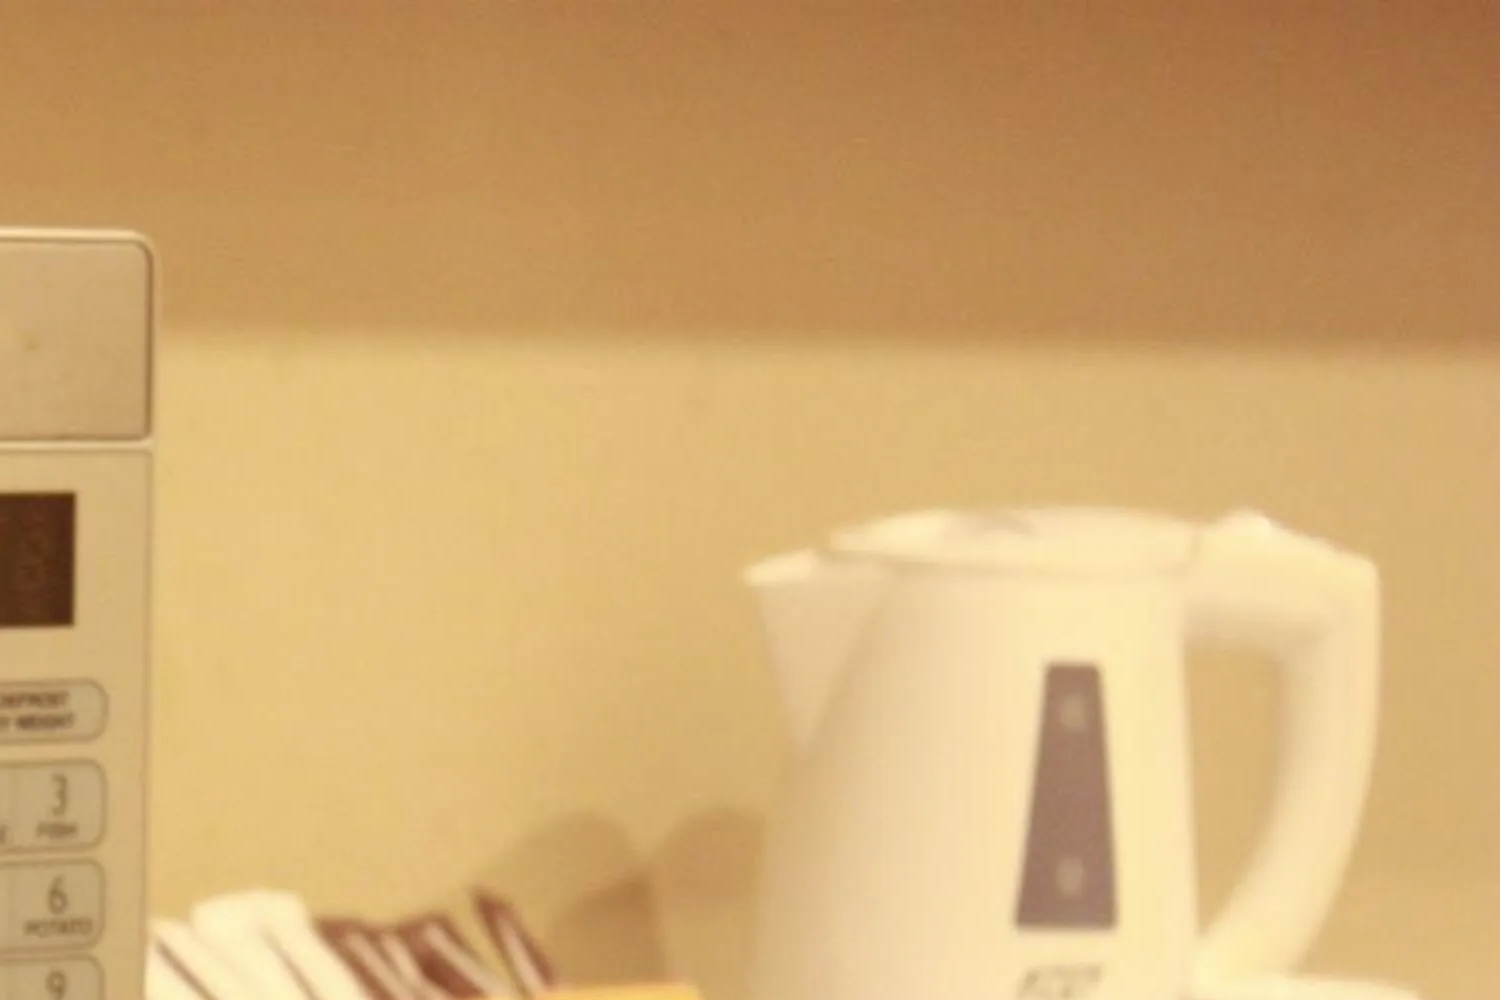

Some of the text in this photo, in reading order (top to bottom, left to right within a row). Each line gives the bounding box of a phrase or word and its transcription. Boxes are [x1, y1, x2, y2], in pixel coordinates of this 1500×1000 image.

[51, 773, 68, 816] 3
[47, 874, 68, 914] 6
[22, 916, 94, 938] POTATO
